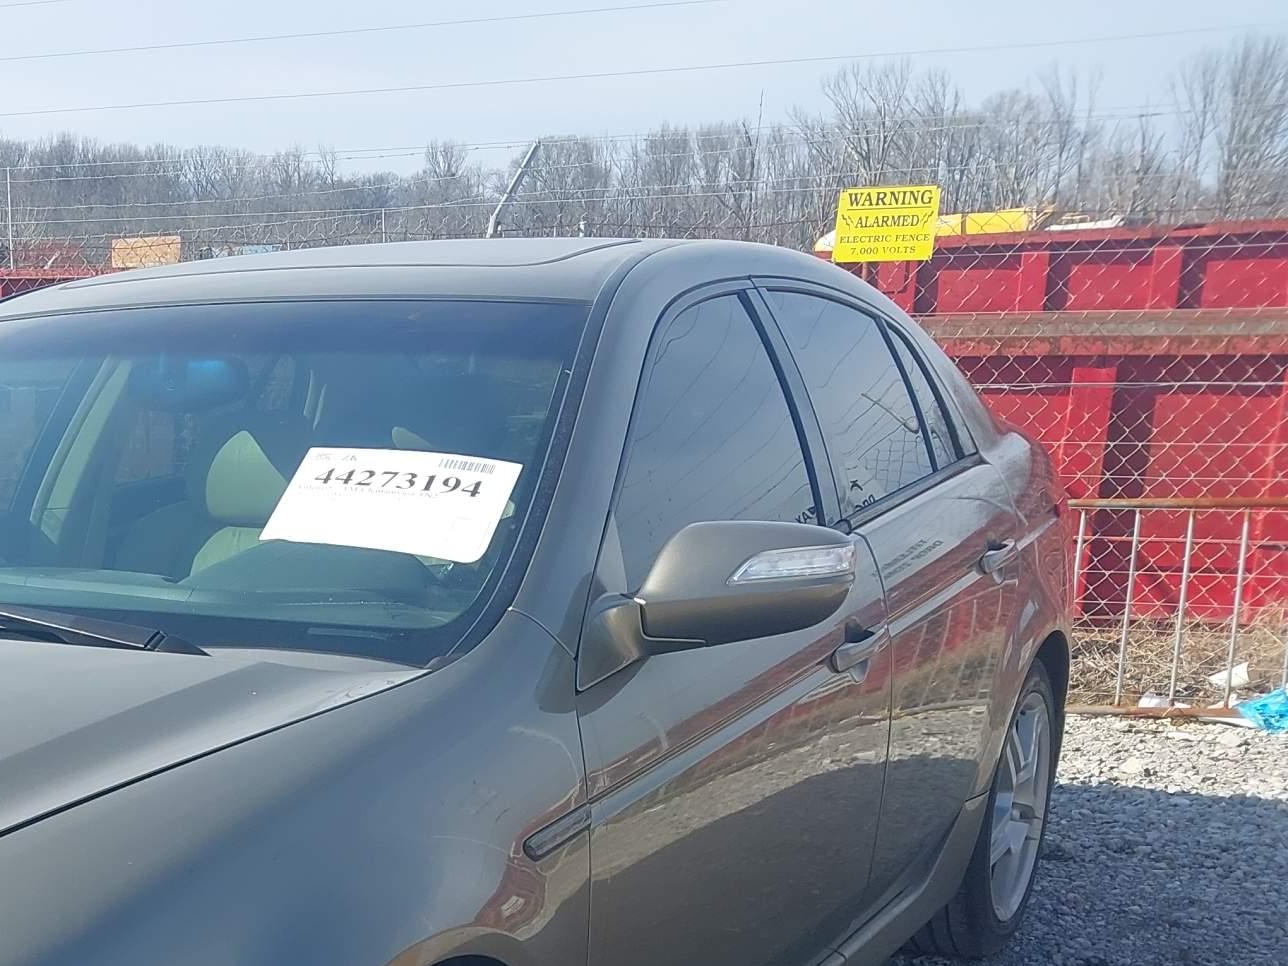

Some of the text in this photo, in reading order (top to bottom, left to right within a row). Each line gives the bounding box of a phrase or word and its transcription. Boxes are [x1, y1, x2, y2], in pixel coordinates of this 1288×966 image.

[848, 190, 933, 207] WARNING
[855, 215, 920, 228] ALARMED
[839, 234, 930, 244] ELECTRIC FENCE
[882, 246, 916, 254] VOLTS
[314, 468, 483, 498] 44273194
